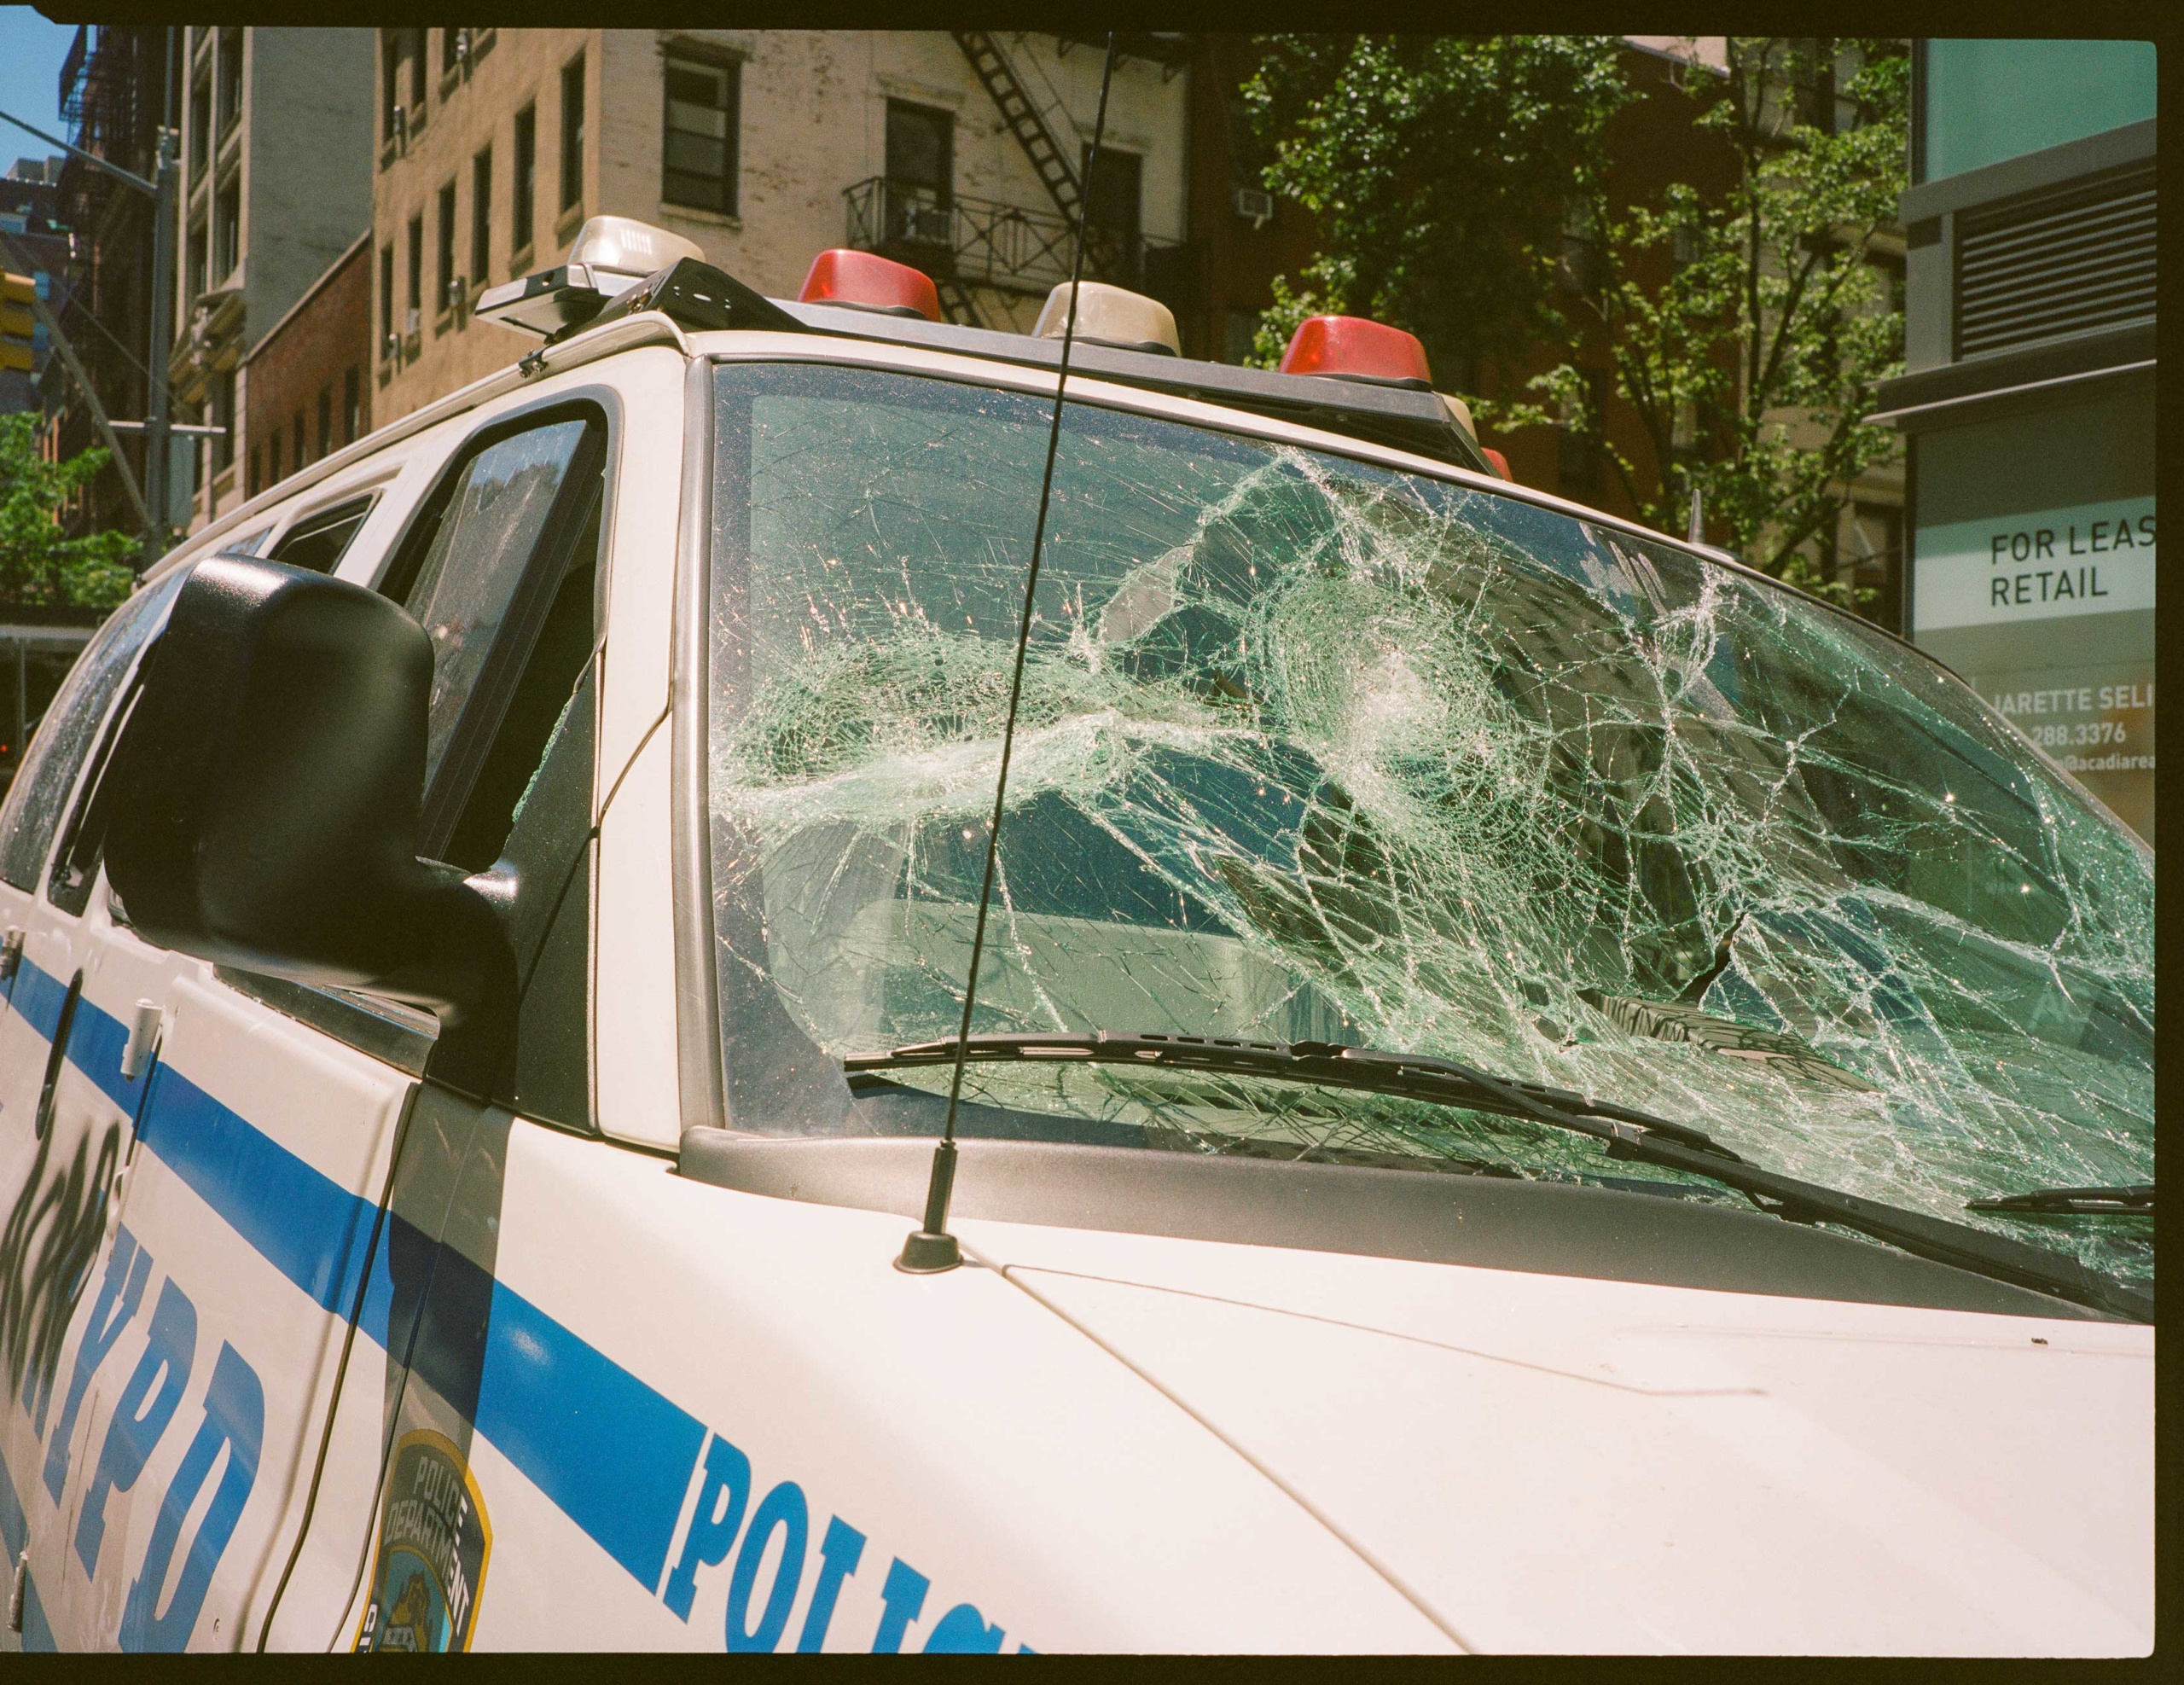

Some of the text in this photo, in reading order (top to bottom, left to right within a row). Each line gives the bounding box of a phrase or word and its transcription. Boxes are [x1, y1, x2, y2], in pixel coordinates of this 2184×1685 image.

[1991, 515, 2155, 565] FOR LEAS
[1991, 567, 2109, 607] RETAIL
[22, 1186, 265, 1653] YPD
[413, 1455, 468, 1545] POLICE
[385, 1499, 469, 1636] DEPARTMENT
